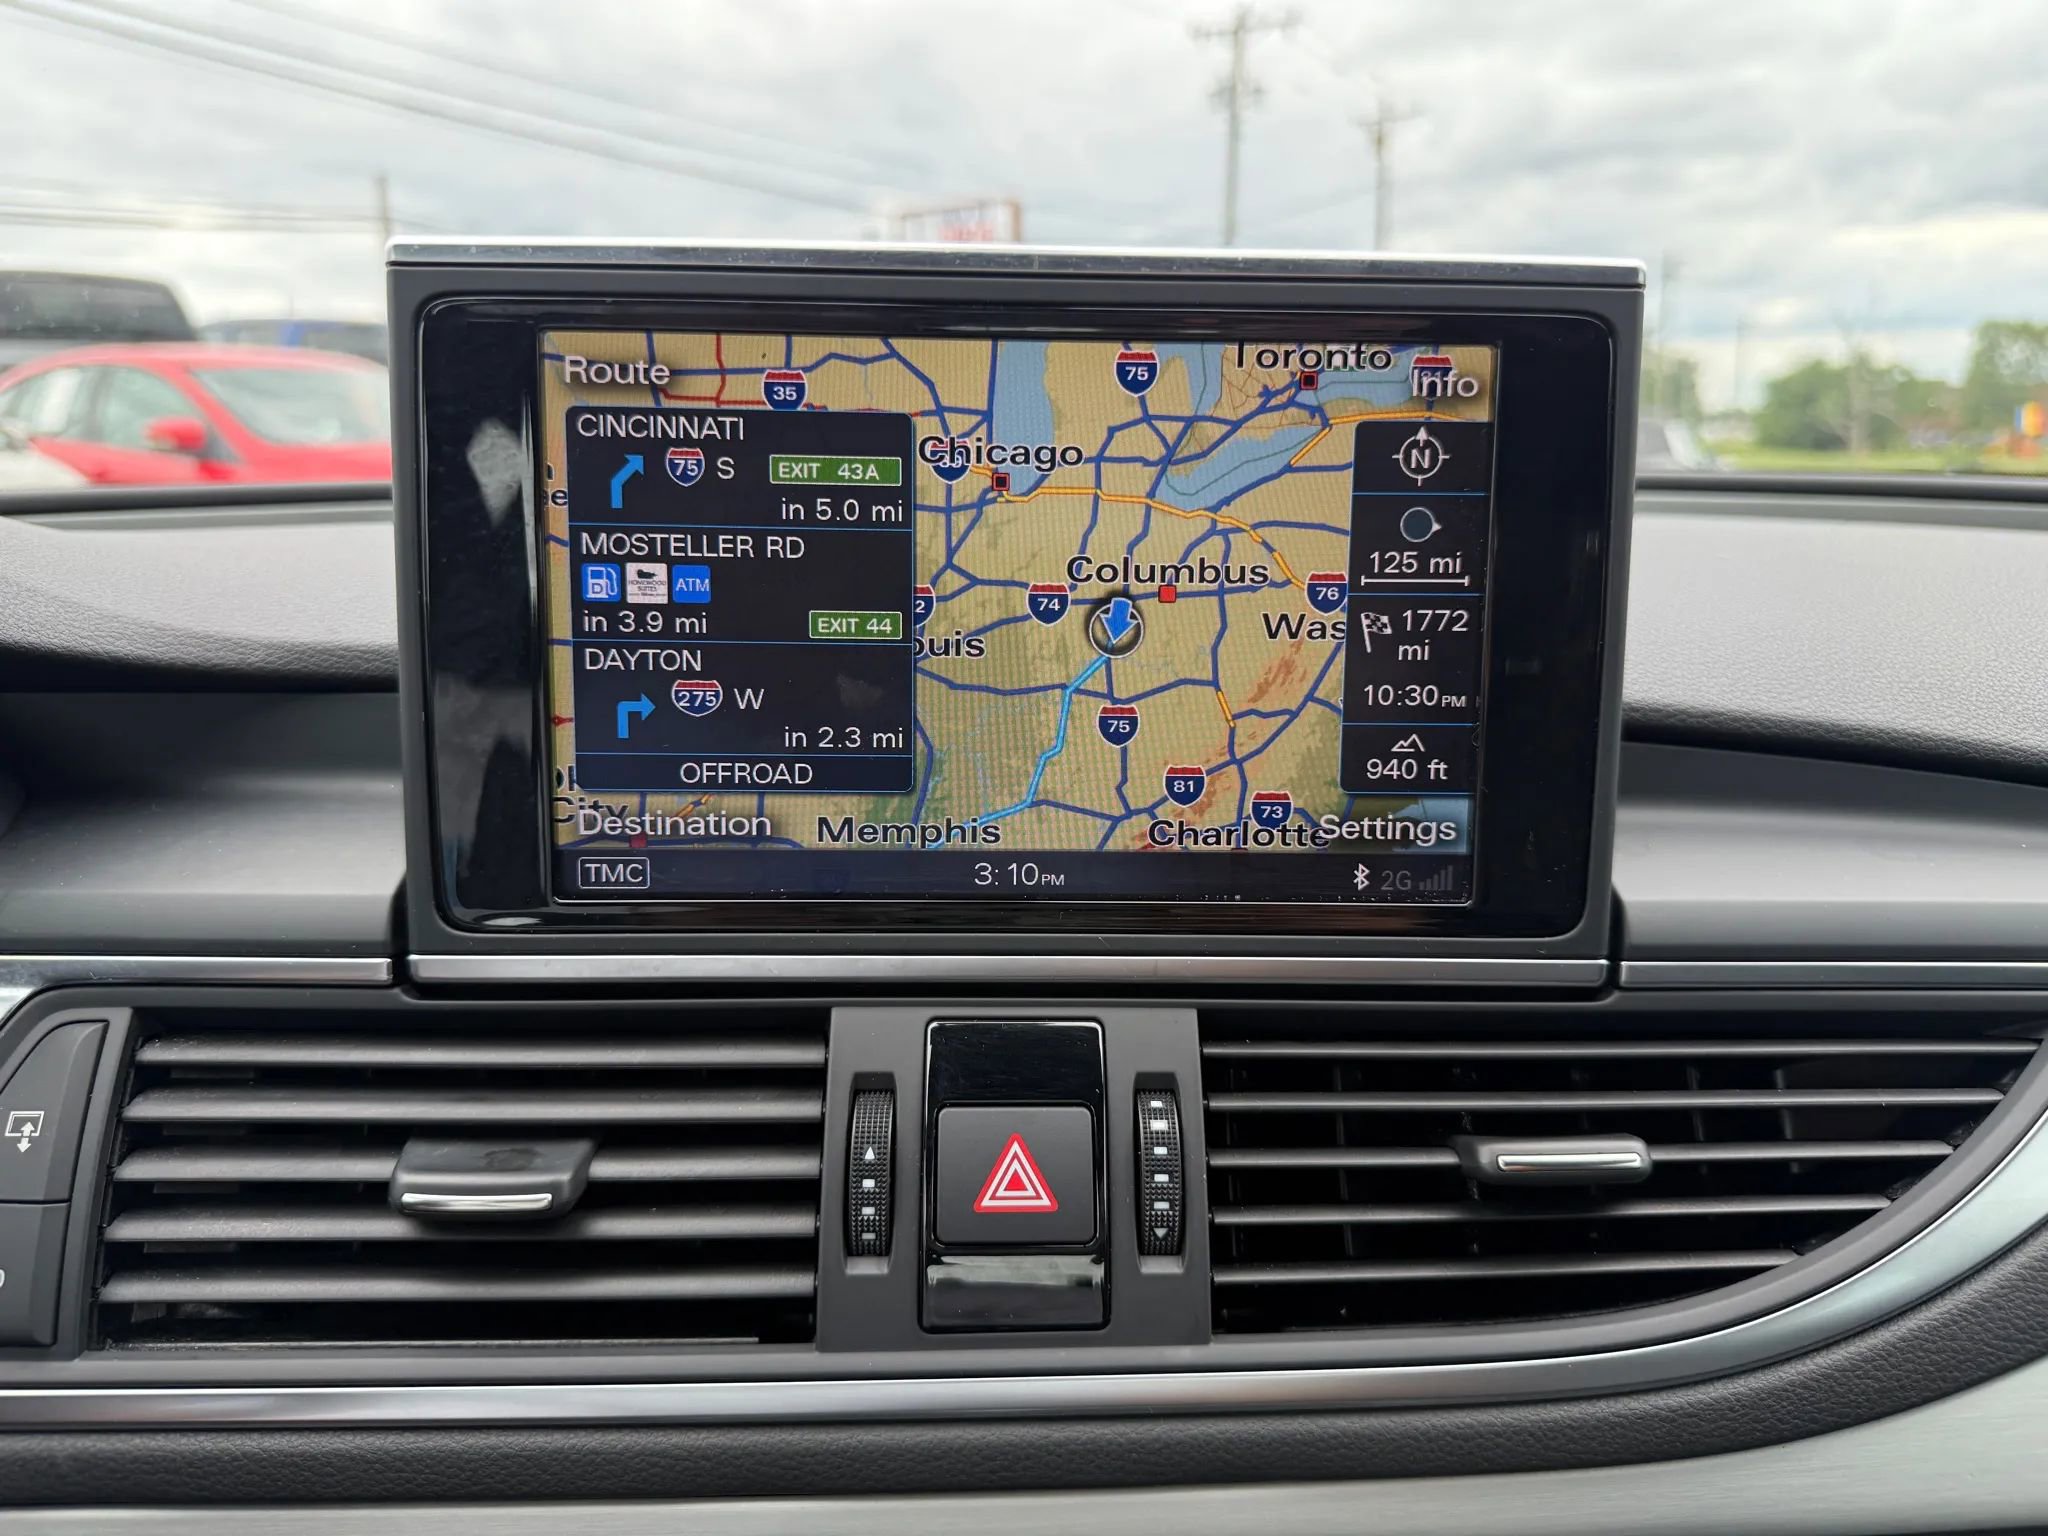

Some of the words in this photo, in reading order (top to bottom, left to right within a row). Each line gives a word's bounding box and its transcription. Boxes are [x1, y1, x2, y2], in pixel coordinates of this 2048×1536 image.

[564, 355, 671, 386] Route
[1125, 367, 1149, 382] 75
[773, 385, 798, 400] 35
[1412, 369, 1478, 398] Info
[576, 414, 745, 441] CINCINNATI
[918, 435, 1084, 473] Chicago
[673, 459, 699, 477] 75
[717, 457, 735, 480] S
[778, 462, 821, 479] EXIT
[837, 463, 880, 481] 43A
[781, 498, 805, 521] in
[815, 499, 860, 522] 5.0
[871, 500, 903, 522] mi
[581, 532, 755, 558] MOSTELLER
[766, 536, 806, 560] RD
[1066, 555, 1270, 586] Columbus
[1368, 551, 1418, 574] 125
[1429, 552, 1463, 574] mi
[675, 577, 710, 592] ATM
[1315, 586, 1340, 601] 76
[1037, 598, 1061, 612] 74
[583, 610, 607, 632] in
[617, 610, 663, 633] 3.9
[675, 612, 708, 634] mi
[818, 618, 860, 634] EXIT
[866, 618, 893, 634] 44
[1402, 610, 1470, 632] 1772
[584, 649, 702, 672] DAYTON
[1398, 640, 1430, 661] mi
[678, 691, 717, 707] 275
[733, 688, 765, 710] W
[784, 726, 807, 748] in
[818, 726, 861, 748] 2.3
[873, 728, 904, 749] mi
[1107, 719, 1131, 734] 75
[680, 763, 813, 785] OFFROAD
[1366, 758, 1418, 780] 940
[1427, 758, 1449, 780] ft
[1173, 780, 1194, 794] 81
[577, 809, 772, 836] Destination
[1260, 805, 1284, 819] 73
[817, 816, 1002, 849] Memphis
[1148, 819, 1330, 849] Charlotte
[1320, 814, 1457, 847] Settings
[584, 863, 644, 883] TMC
[1380, 870, 1412, 890] 2G
